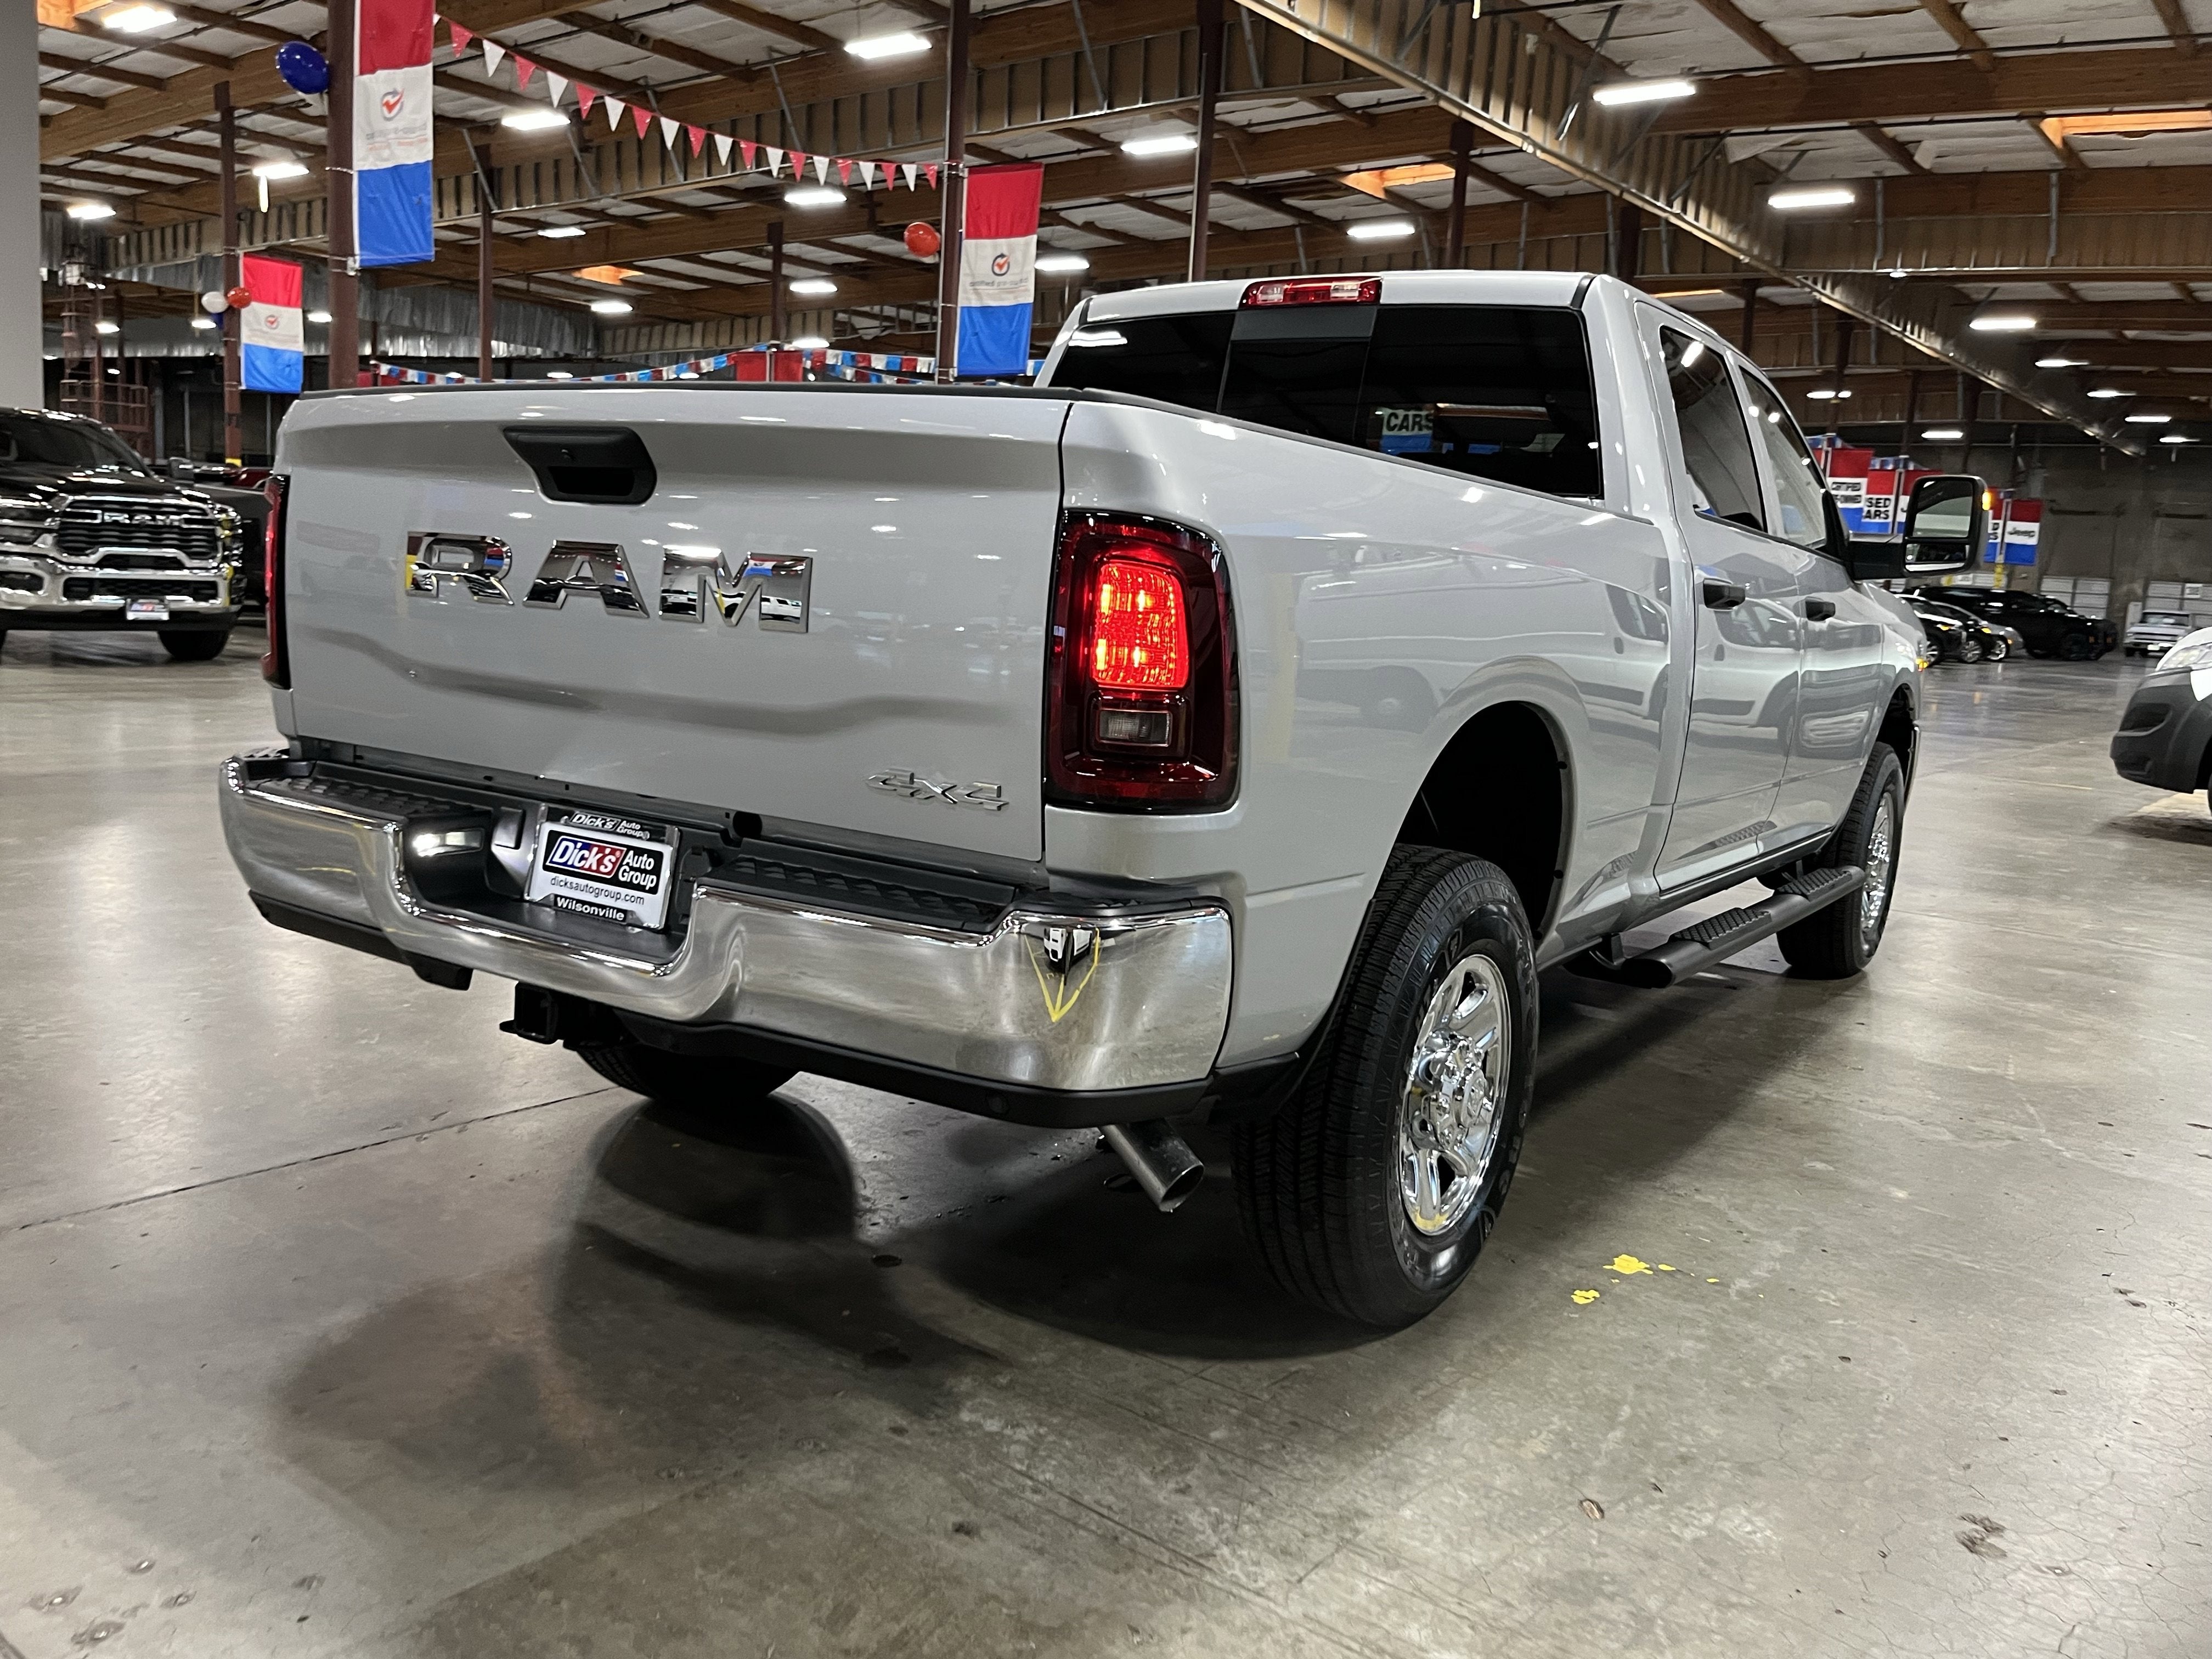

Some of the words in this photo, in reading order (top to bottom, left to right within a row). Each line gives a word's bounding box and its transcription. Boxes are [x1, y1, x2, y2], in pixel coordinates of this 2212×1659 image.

[1386, 412, 1434, 432] CARS
[1866, 498, 1892, 508] SED
[103, 512, 184, 526] RAM
[1864, 510, 1890, 520] ARS
[2007, 527, 2035, 539] Jeep
[406, 531, 814, 634] RAM
[572, 814, 616, 830] Dick's
[620, 820, 641, 830] Auto
[617, 826, 644, 838] Group
[552, 840, 616, 873] Dick's
[623, 850, 654, 870] Auto
[618, 866, 657, 890] Group
[550, 876, 645, 905] dicksautogroup.com
[556, 897, 625, 921] Wilsonville
